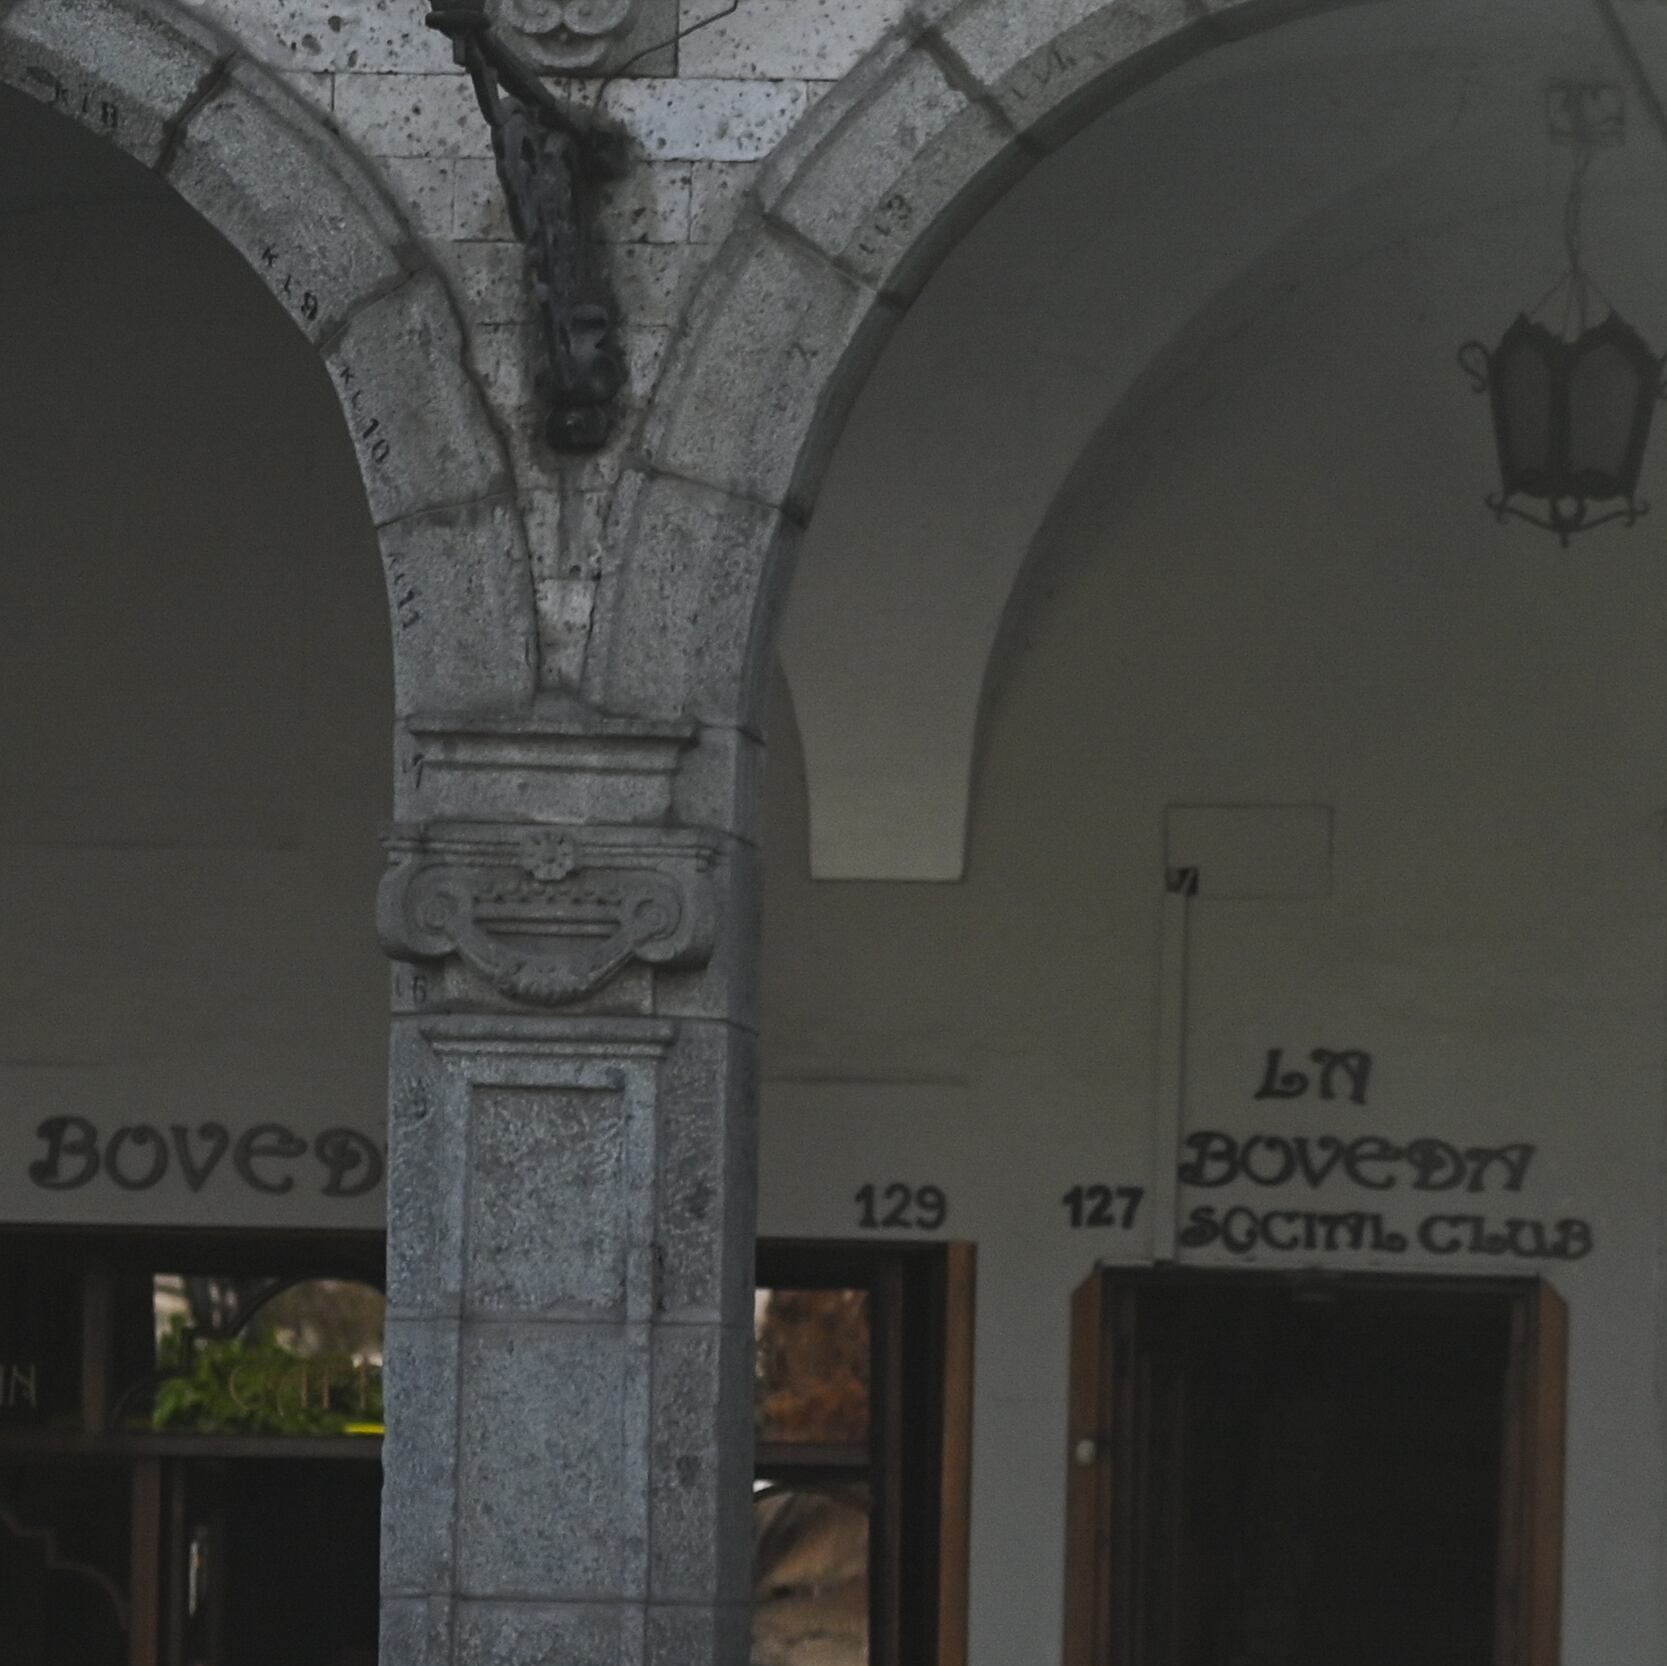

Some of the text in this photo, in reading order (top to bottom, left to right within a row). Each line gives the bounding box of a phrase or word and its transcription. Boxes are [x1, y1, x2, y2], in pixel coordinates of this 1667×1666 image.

[1253, 1047, 1372, 1105] LA
[1177, 1129, 1537, 1193] BOVEDA
[854, 1183, 949, 1230] 129
[1061, 1184, 1145, 1230] 127
[1178, 1205, 1596, 1262] SOCIAL CLUB
